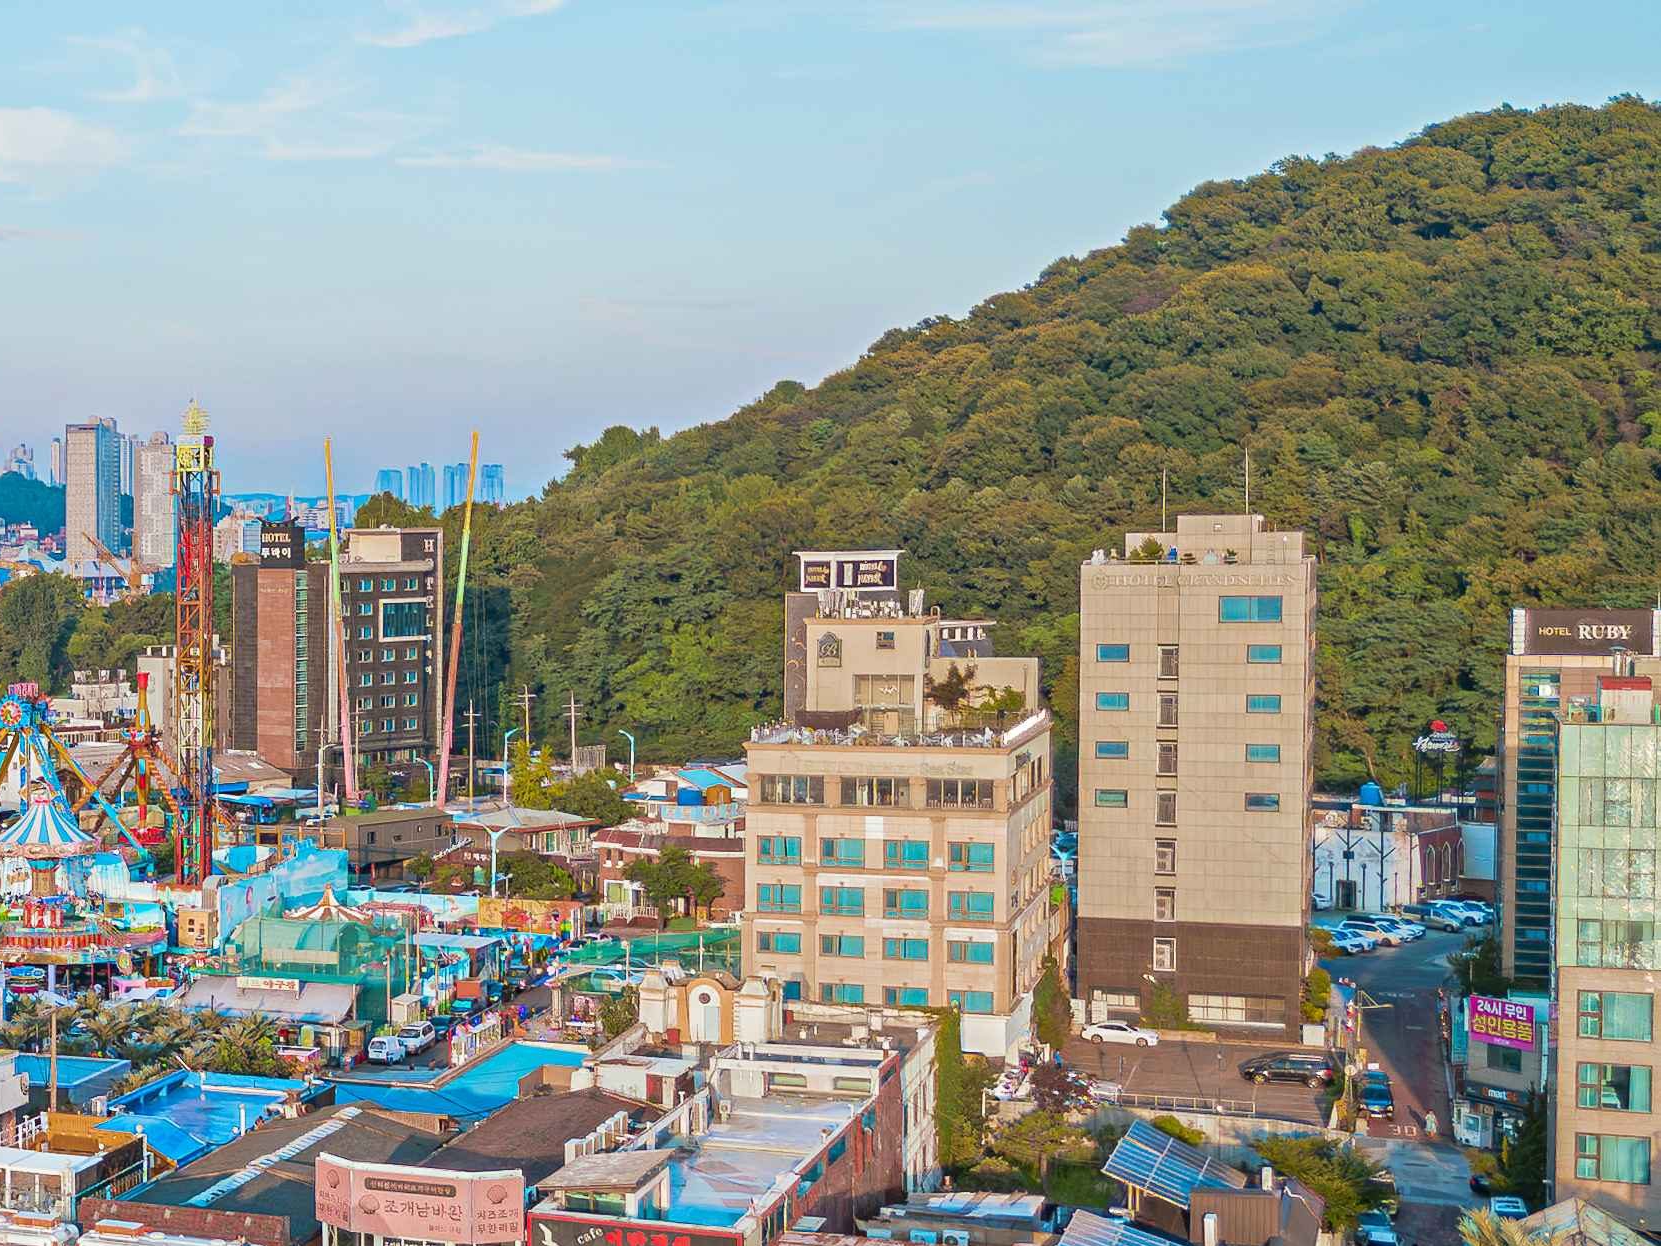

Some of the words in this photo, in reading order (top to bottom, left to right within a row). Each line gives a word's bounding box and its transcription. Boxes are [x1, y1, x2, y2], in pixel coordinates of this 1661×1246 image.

[261, 533, 292, 543] HOTEL
[261, 547, 292, 559] 두바이
[1538, 627, 1572, 636] HOTEL
[1579, 624, 1632, 640] RUBY
[1476, 1000, 1502, 1017] 24시
[1504, 1004, 1527, 1021] 무인
[1473, 1016, 1532, 1042] 성인용품
[1388, 1123, 1418, 1137] 30
[577, 1227, 604, 1245] cafe
